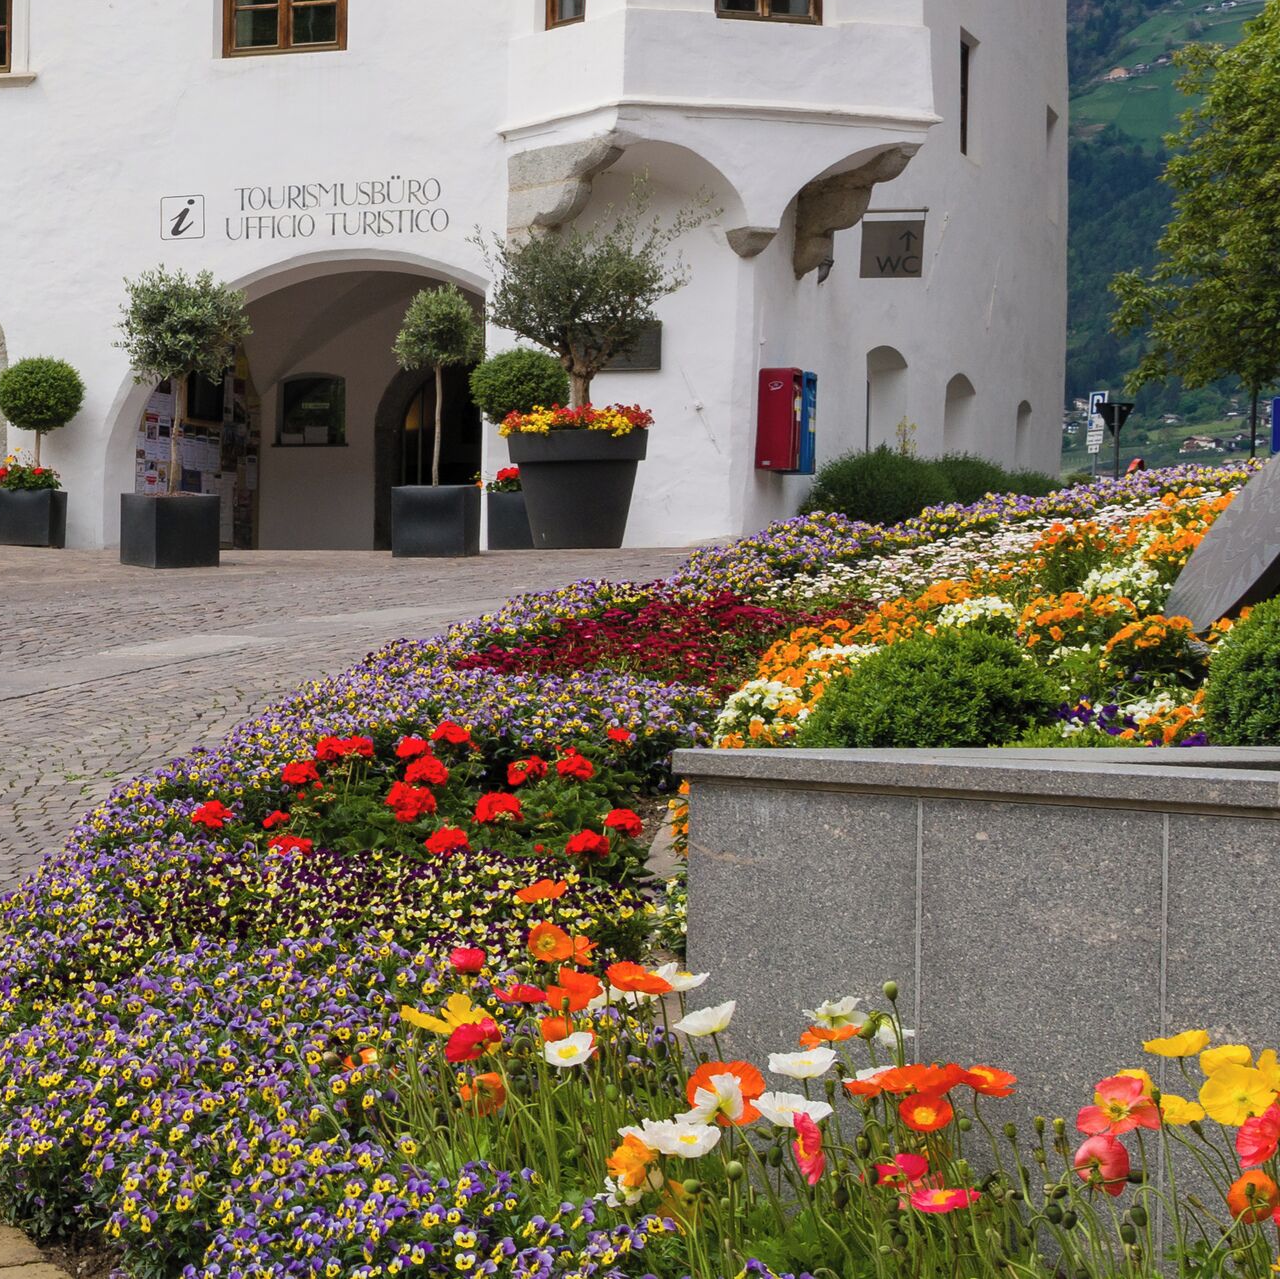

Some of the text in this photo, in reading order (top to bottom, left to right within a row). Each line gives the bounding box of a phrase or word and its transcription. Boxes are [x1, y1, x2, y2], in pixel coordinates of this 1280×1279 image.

[234, 175, 441, 212] TOURISMUSBÜRO
[225, 207, 450, 241] UFFICIO TURISTICO
[875, 255, 920, 274] WC
[1093, 395, 1104, 413] P
